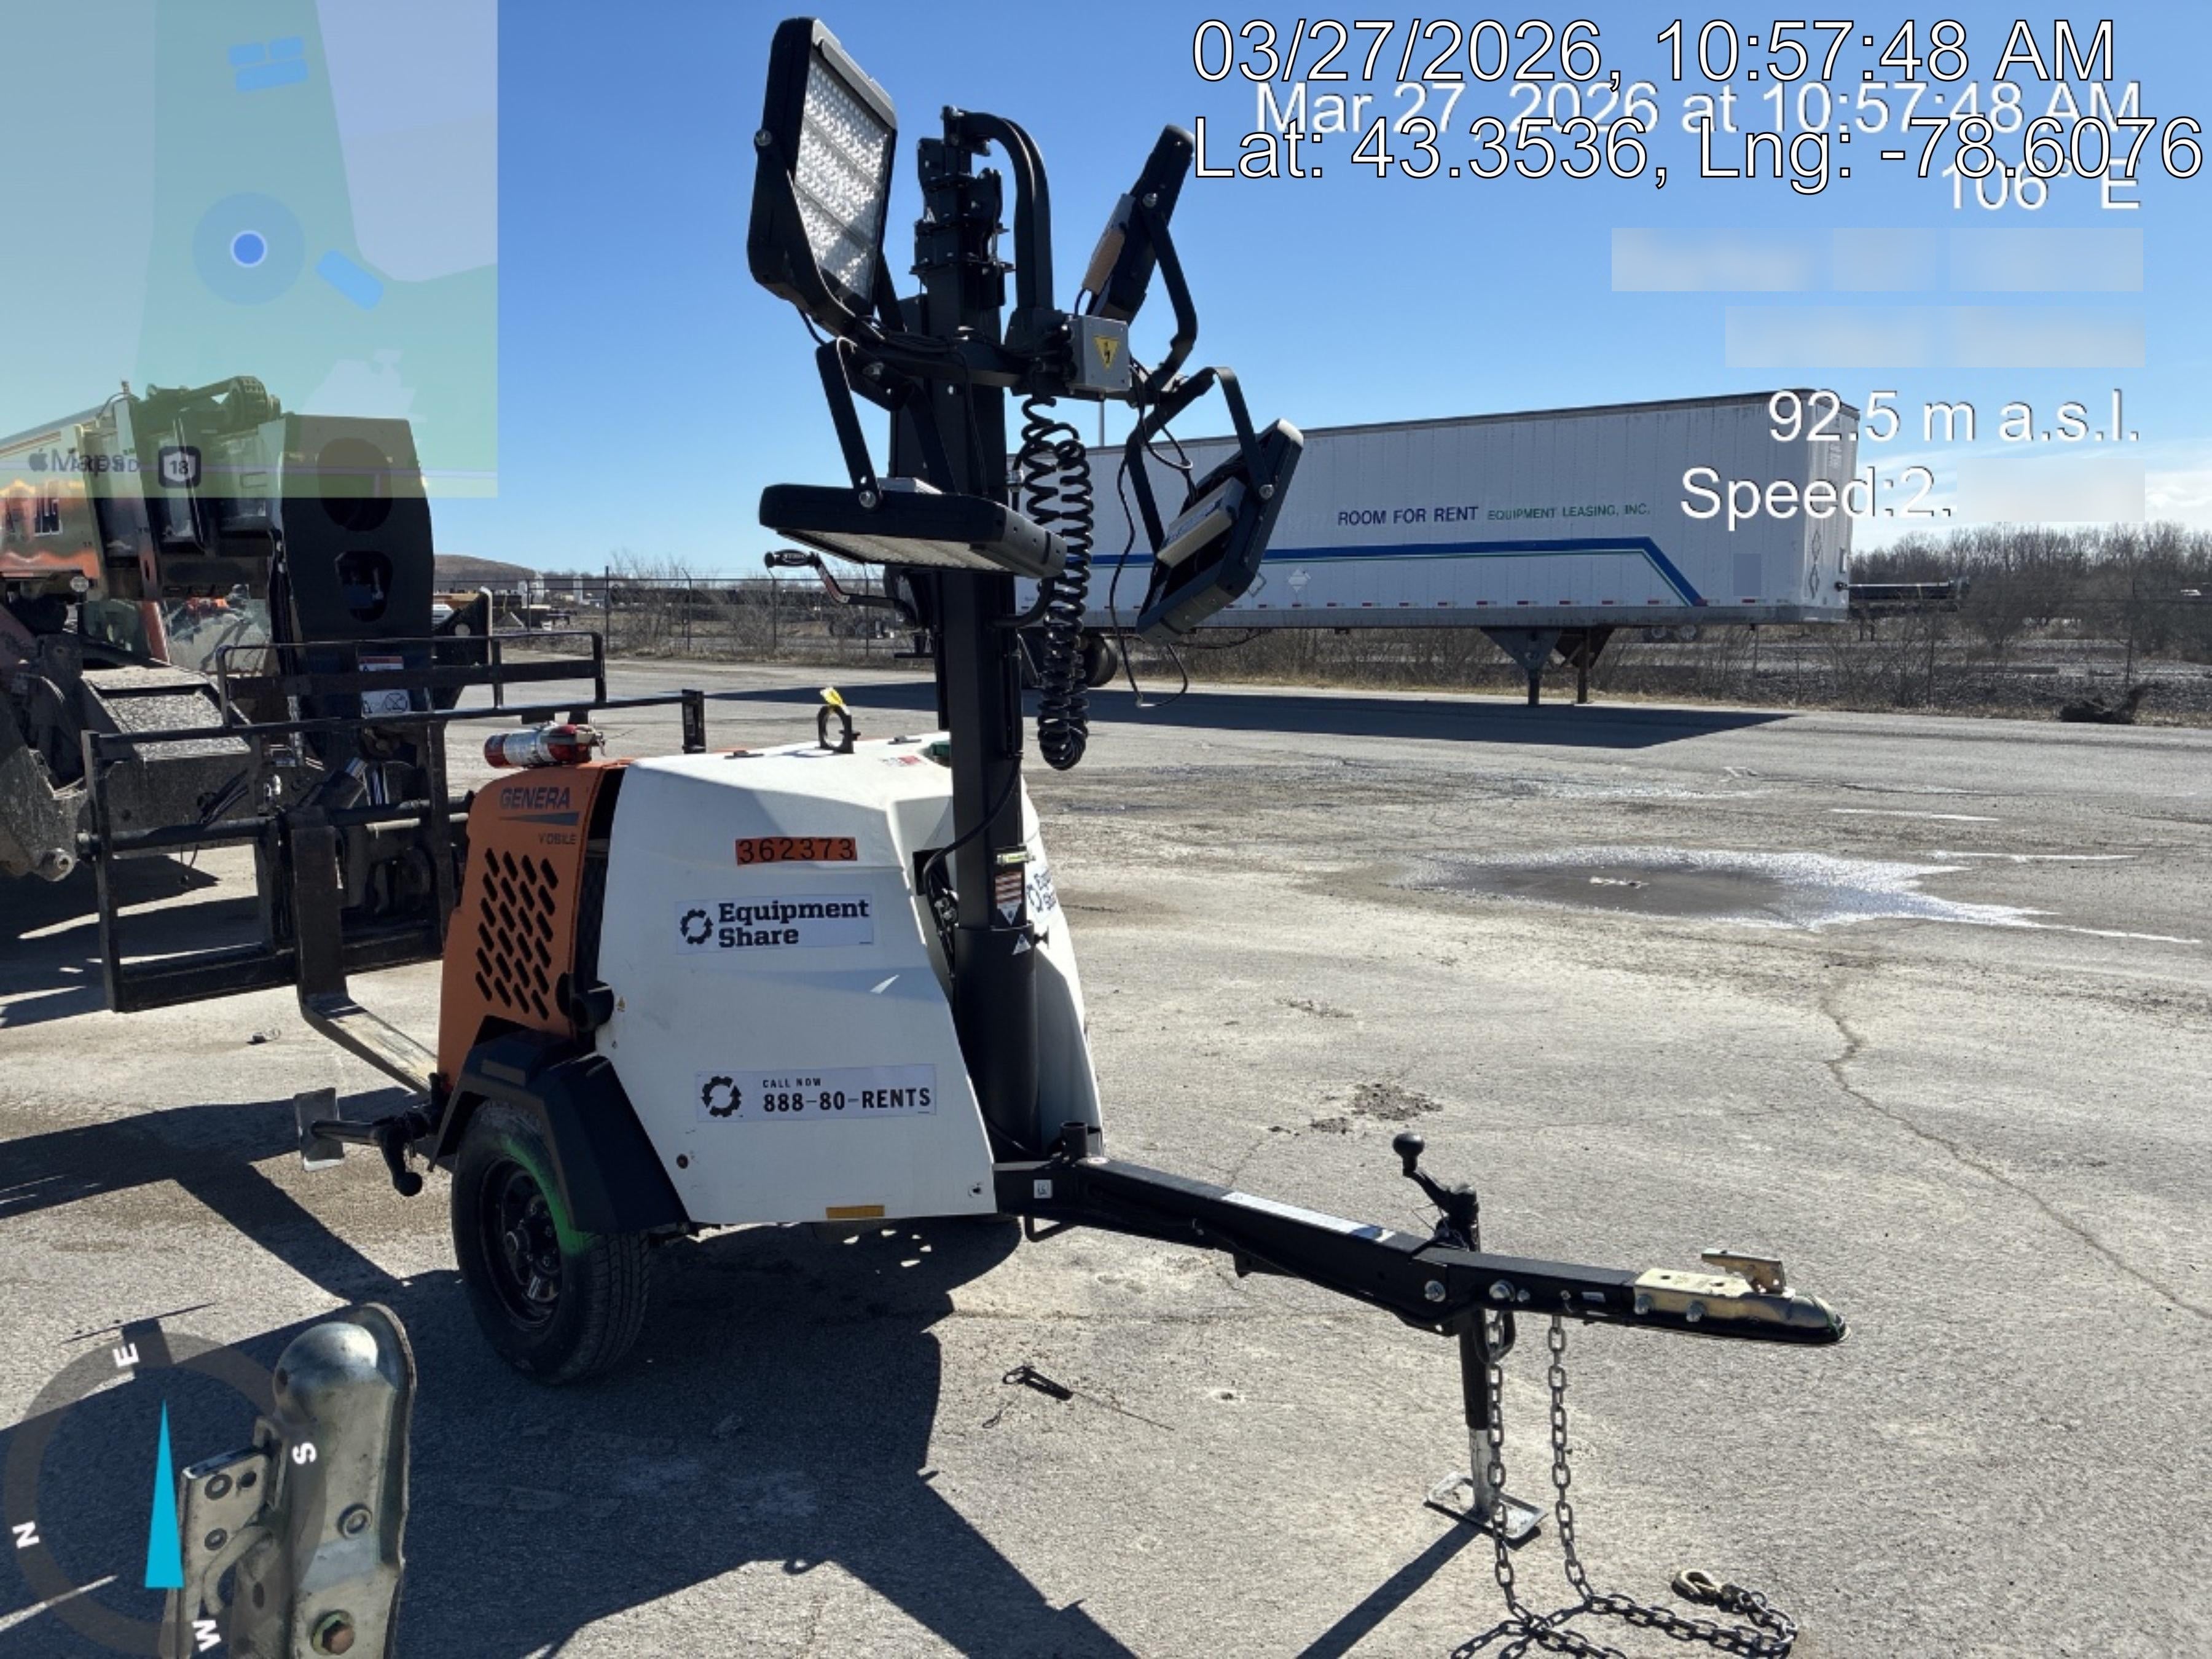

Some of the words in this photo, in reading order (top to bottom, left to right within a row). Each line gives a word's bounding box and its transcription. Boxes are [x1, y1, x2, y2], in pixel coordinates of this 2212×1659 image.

[1338, 511, 1387, 526] ROOM
[1394, 509, 1427, 524] FOR
[1433, 506, 1479, 522] RENT
[1488, 508, 1556, 520] EQUIPMENT
[1563, 504, 1620, 518] LEASING,
[1625, 503, 1651, 516] INC.
[739, 838, 855, 863] 362373
[718, 899, 869, 927] Equipment
[718, 926, 799, 948] Share
[763, 1079, 791, 1089] CALL
[796, 1078, 822, 1088] NOW
[763, 1087, 931, 1113] 888-80-RENTS
